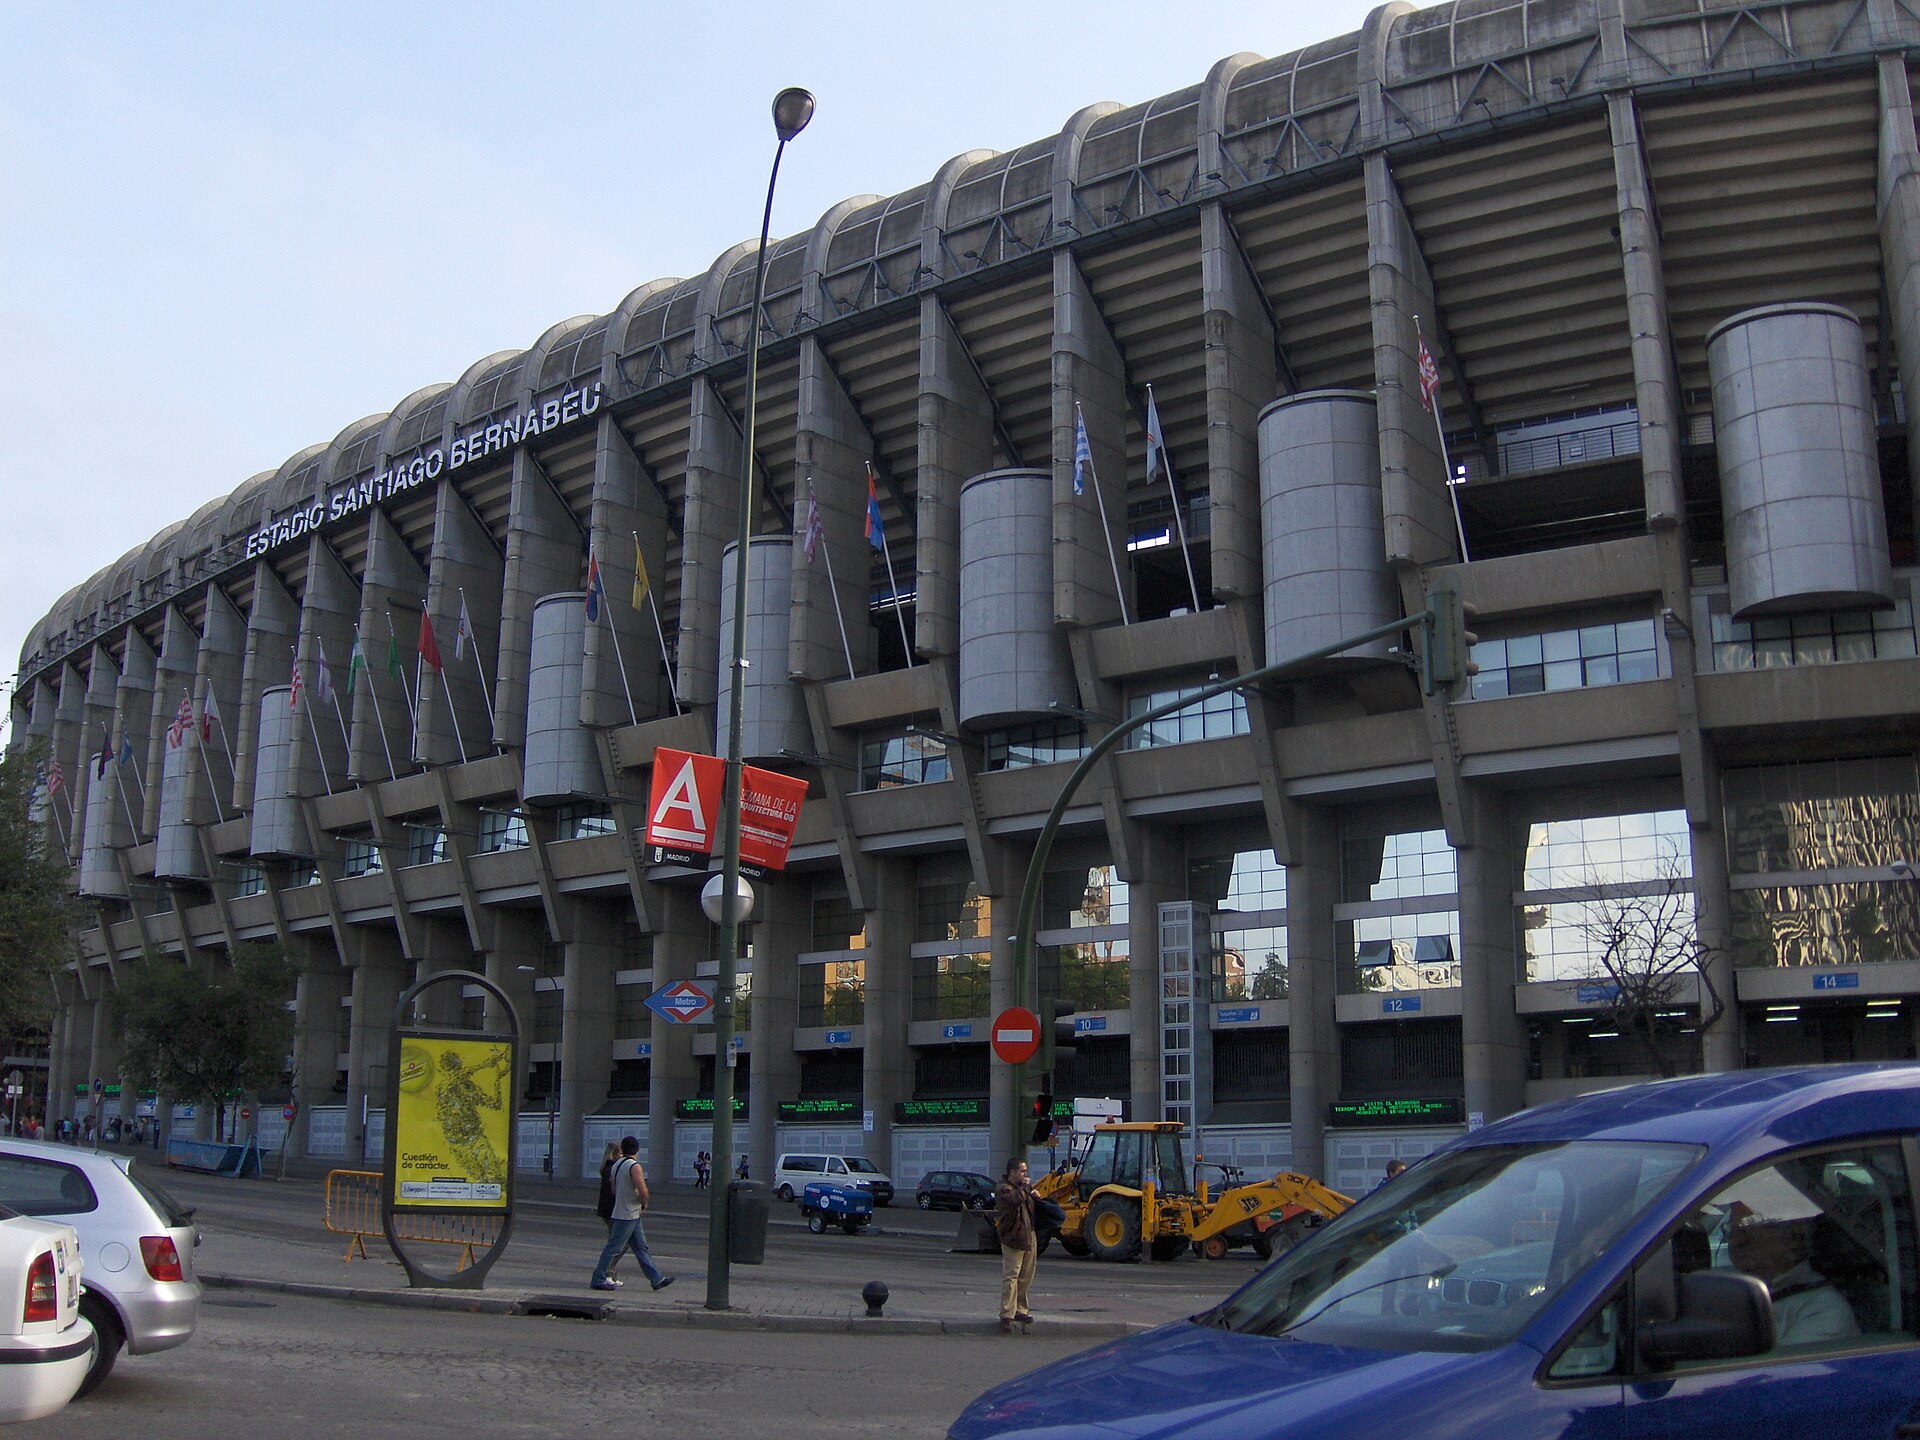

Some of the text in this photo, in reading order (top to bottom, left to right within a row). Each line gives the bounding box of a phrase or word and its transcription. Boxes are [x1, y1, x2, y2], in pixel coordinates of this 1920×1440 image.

[246, 382, 602, 560] ESTADIO SANTIAGO BERNABEU
[653, 756, 706, 830] A
[773, 797, 785, 810] DE
[785, 801, 796, 814] LA
[666, 853, 690, 862] MADRID
[1821, 976, 1837, 988] 14
[675, 997, 697, 1006] Metro
[1390, 999, 1403, 1011] 12
[1080, 1019, 1091, 1030] 10
[947, 1026, 954, 1037] 8
[829, 1032, 835, 1043] 6
[641, 1045, 646, 1053] 2
[402, 1153, 438, 1161] Cuestión
[402, 1161, 413, 1169] de
[1241, 1196, 1260, 1213] JCB
